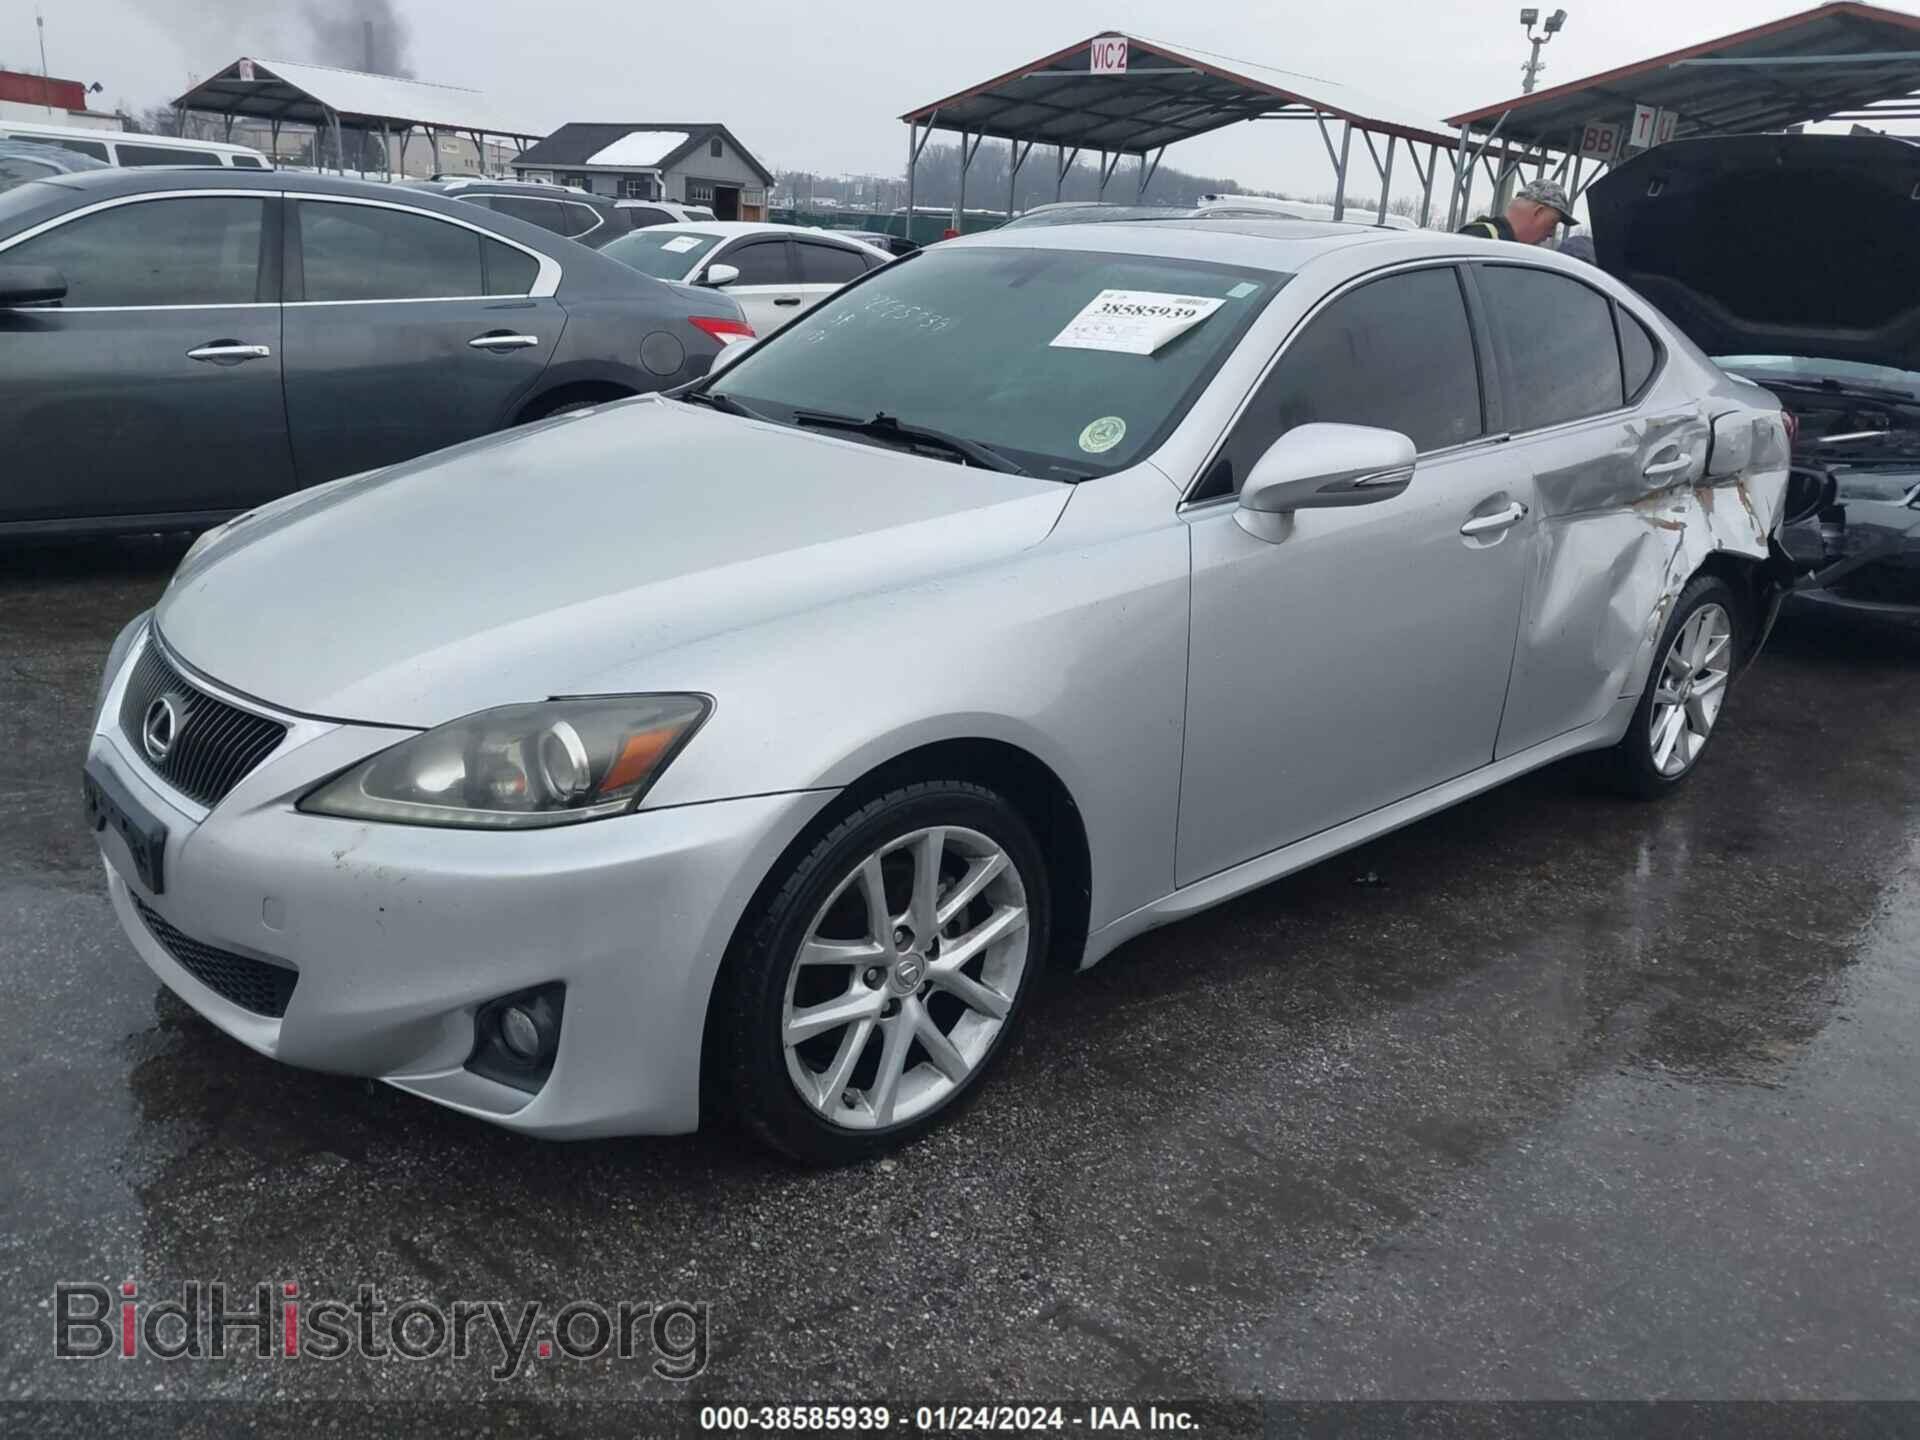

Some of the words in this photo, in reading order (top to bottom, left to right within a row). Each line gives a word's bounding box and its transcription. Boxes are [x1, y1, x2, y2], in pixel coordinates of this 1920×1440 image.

[1092, 43, 1114, 69] VIC
[1117, 43, 1126, 68] 2
[1639, 112, 1651, 139] T
[1583, 127, 1613, 153] BB
[1096, 302, 1197, 319] 38585939
